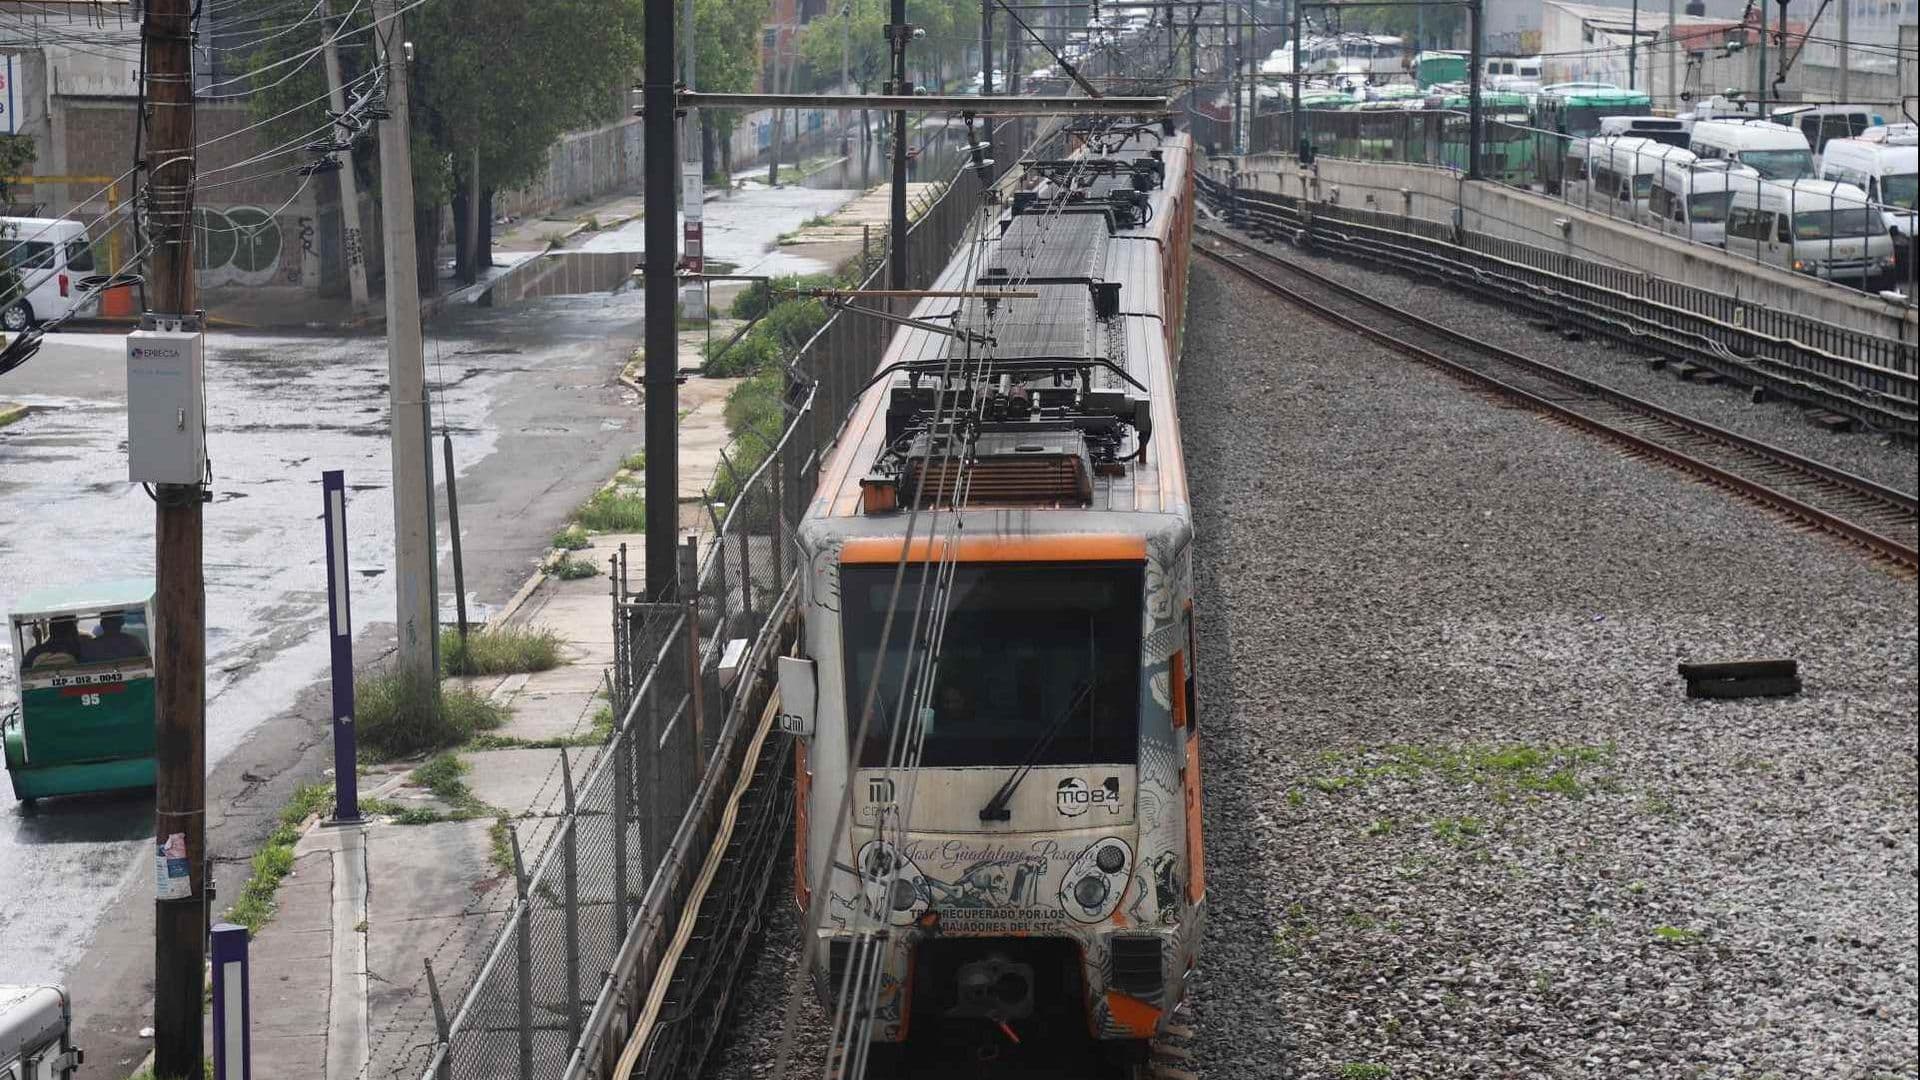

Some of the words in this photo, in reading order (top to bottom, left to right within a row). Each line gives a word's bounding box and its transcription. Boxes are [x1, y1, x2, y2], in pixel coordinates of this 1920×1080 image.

[81, 693, 100, 706] 95
[902, 840, 940, 866] José
[943, 909, 1016, 919] RECUPERADO
[1019, 909, 1041, 919] POR
[1044, 909, 1066, 919] LOS
